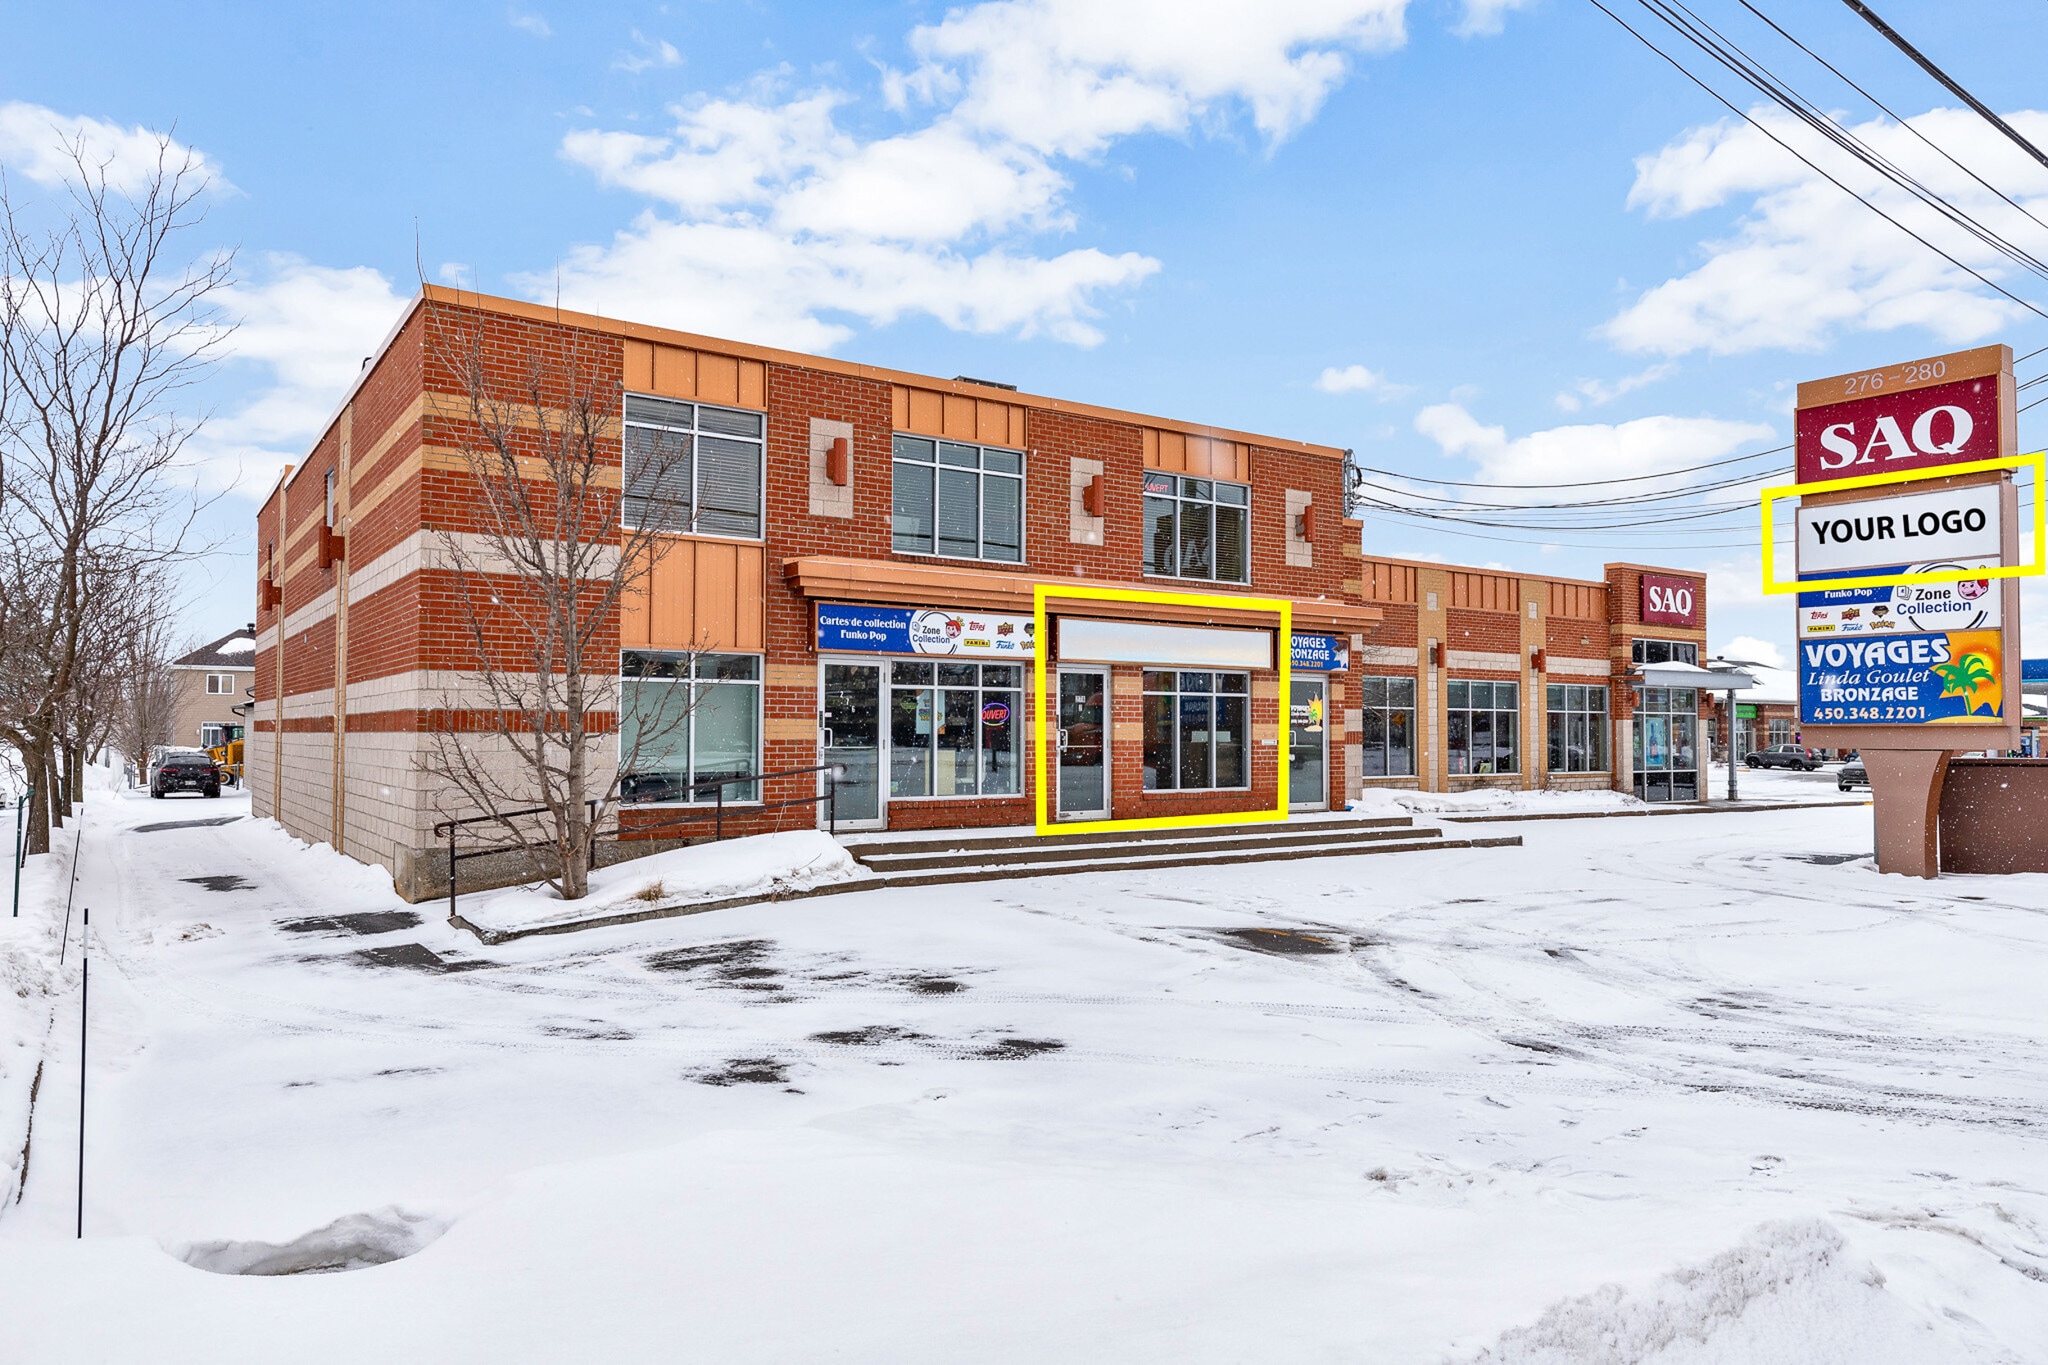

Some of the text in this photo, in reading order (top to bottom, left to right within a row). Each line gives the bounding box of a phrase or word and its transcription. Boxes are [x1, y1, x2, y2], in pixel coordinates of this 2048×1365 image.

[1844, 372, 1884, 395] 276
[1904, 360, 1946, 384] 280
[1820, 405, 1974, 470] SAQ
[1854, 588, 1873, 597] Pop
[1915, 589, 1951, 601] Zone
[1649, 585, 1692, 617] SAQ
[1896, 600, 1972, 615] Collection
[819, 615, 907, 629] Cartes de collection
[1841, 623, 1863, 632] Funko
[840, 629, 887, 642] Funko Pop
[922, 625, 941, 635] Zone
[912, 634, 951, 644] Collection
[995, 640, 1015, 650] Funko
[1290, 635, 1327, 649] OYAGES
[1290, 648, 1330, 661] RONZAGE
[1805, 638, 1951, 669] VOYAGES
[1807, 667, 1930, 686] Linda Goulet
[1820, 686, 1919, 703] BRONZAGE
[981, 709, 1008, 720] OUVERT
[1814, 706, 1925, 720] 450.348.2201
